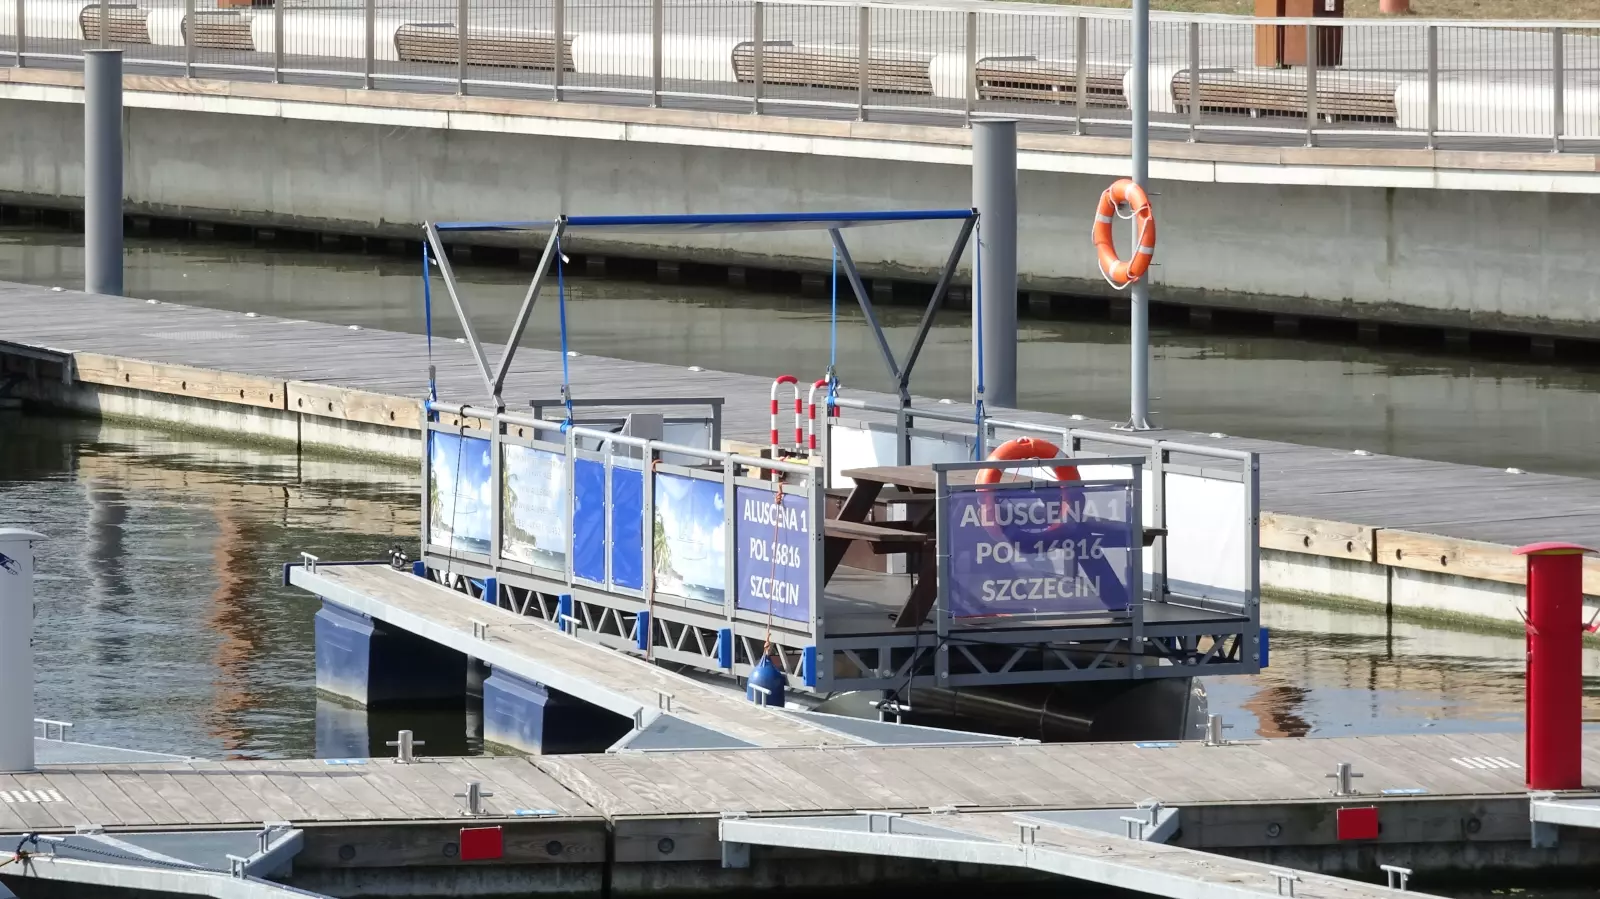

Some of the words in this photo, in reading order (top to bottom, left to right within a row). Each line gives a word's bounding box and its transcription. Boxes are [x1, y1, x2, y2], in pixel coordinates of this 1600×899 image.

[744, 498, 798, 532] ALUSCENA
[800, 510, 808, 533] 1
[960, 500, 1102, 528] ALUSCENA
[1108, 498, 1120, 519] 1
[750, 537, 769, 562] POL
[771, 542, 800, 569] 16816
[977, 541, 1026, 565] POL
[1033, 538, 1104, 562] 16816
[750, 574, 799, 606] SZCZECIN
[982, 575, 1101, 602] SZCZECIN
